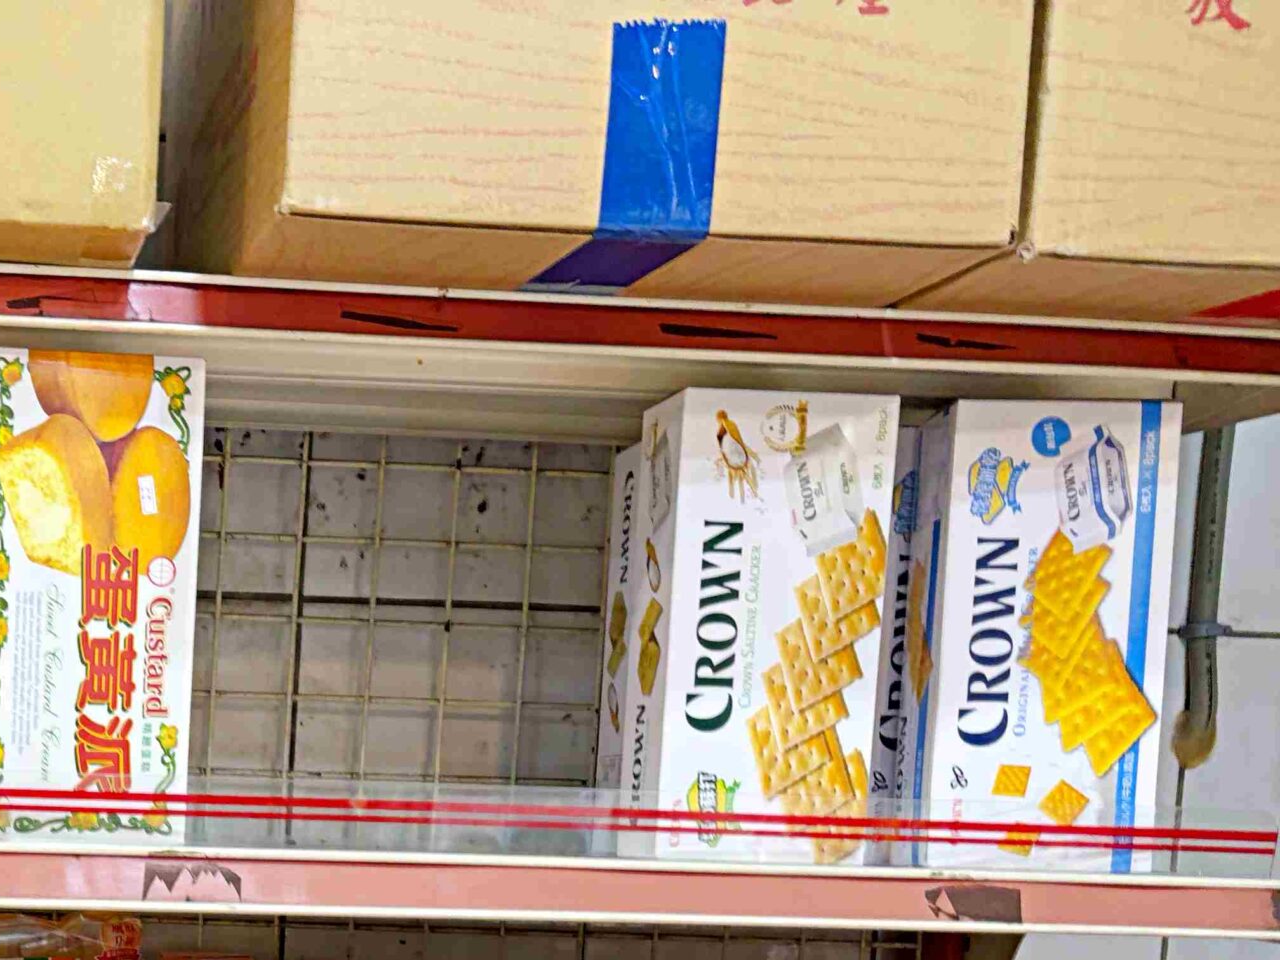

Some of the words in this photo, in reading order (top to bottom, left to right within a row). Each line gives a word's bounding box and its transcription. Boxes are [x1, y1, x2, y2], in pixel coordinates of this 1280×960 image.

[796, 461, 817, 522] CROWN
[1061, 462, 1081, 521] CROWN
[73, 543, 139, 793] 蛋黃派
[142, 597, 173, 719] Custard
[685, 517, 745, 733] CROWN
[957, 536, 1020, 747] CROWN
